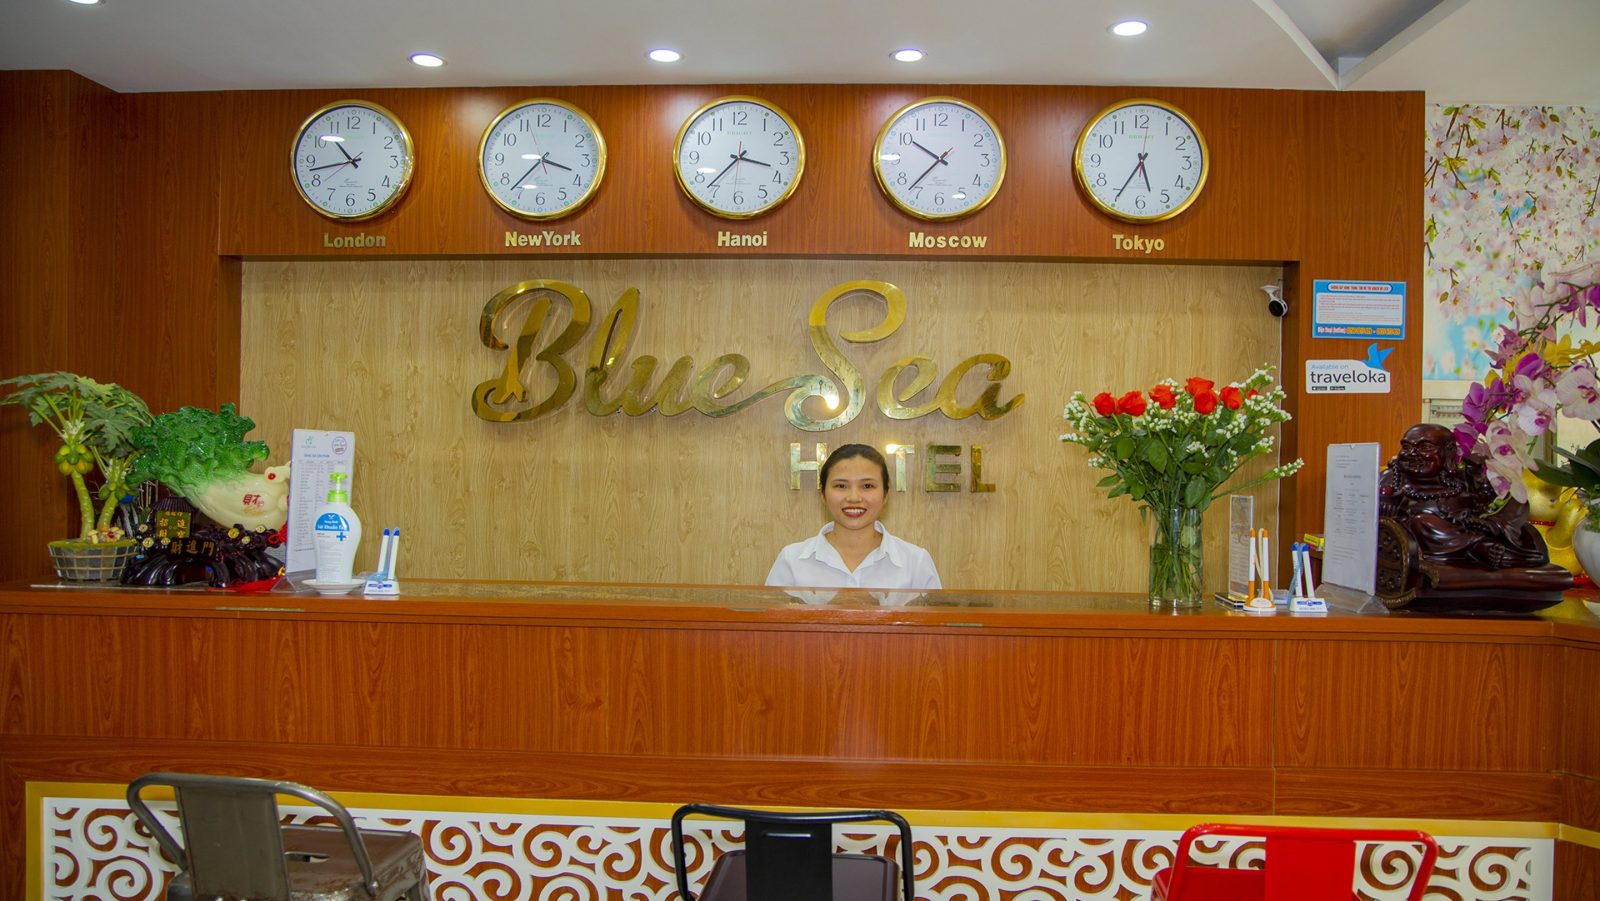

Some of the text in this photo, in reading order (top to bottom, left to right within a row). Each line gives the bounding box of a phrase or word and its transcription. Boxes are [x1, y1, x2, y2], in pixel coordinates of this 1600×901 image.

[347, 116, 360, 129] 12
[538, 114, 551, 127] 12
[713, 118, 722, 131] 11
[733, 111, 747, 125] 12
[763, 118, 767, 131] 1
[934, 113, 948, 126] 12
[1135, 115, 1149, 128] 12
[330, 121, 339, 134] 11
[372, 122, 376, 134] 1
[520, 120, 529, 131] 11
[563, 120, 567, 132] 1
[916, 119, 925, 131] 11
[961, 119, 965, 132] 1
[1114, 121, 1124, 134] 11
[1165, 122, 1169, 136] 1
[314, 136, 326, 148] 10
[384, 136, 393, 149] 2
[504, 133, 516, 146] 10
[575, 135, 584, 147] 2
[698, 132, 711, 145] 10
[773, 132, 783, 146] 2
[900, 133, 912, 145] 10
[974, 134, 983, 147] 2
[1100, 135, 1113, 149] 10
[1175, 136, 1185, 150] 2
[306, 154, 315, 168] 9
[390, 156, 398, 168] 3
[495, 153, 504, 166] 9
[580, 154, 590, 167] 3
[689, 151, 699, 164] 9
[780, 152, 789, 165] 3
[981, 154, 989, 167] 3
[1091, 154, 1100, 168] 9
[1182, 156, 1191, 170] 3
[311, 174, 321, 187] 8
[382, 175, 390, 188] 4
[500, 173, 510, 185] 8
[573, 174, 581, 187] 4
[695, 169, 705, 183] 8
[773, 170, 781, 184] 4
[897, 172, 906, 185] 8
[973, 174, 981, 187] 4
[1096, 173, 1106, 186] 8
[1175, 175, 1183, 189] 4
[328, 188, 336, 200] 7
[367, 189, 376, 201] 5
[516, 186, 524, 199] 7
[558, 188, 567, 200] 5
[710, 185, 720, 198] 7
[733, 191, 743, 205] 6
[758, 185, 767, 198] 5
[914, 187, 923, 199] 7
[957, 188, 966, 200] 5
[1113, 188, 1121, 202] 7
[1160, 189, 1170, 203] 5
[346, 194, 355, 206] 6
[536, 192, 545, 205] 6
[935, 192, 944, 205] 6
[1135, 195, 1145, 209] 6
[323, 232, 386, 248] London
[505, 231, 581, 247] NewYork
[717, 231, 768, 247] Hanoi
[908, 232, 987, 248] Moscow
[1112, 234, 1165, 253] Tokyo
[472, 279, 1025, 432] Blue Sea
[1310, 370, 1386, 383] traveloka
[790, 443, 996, 492] HTEL
